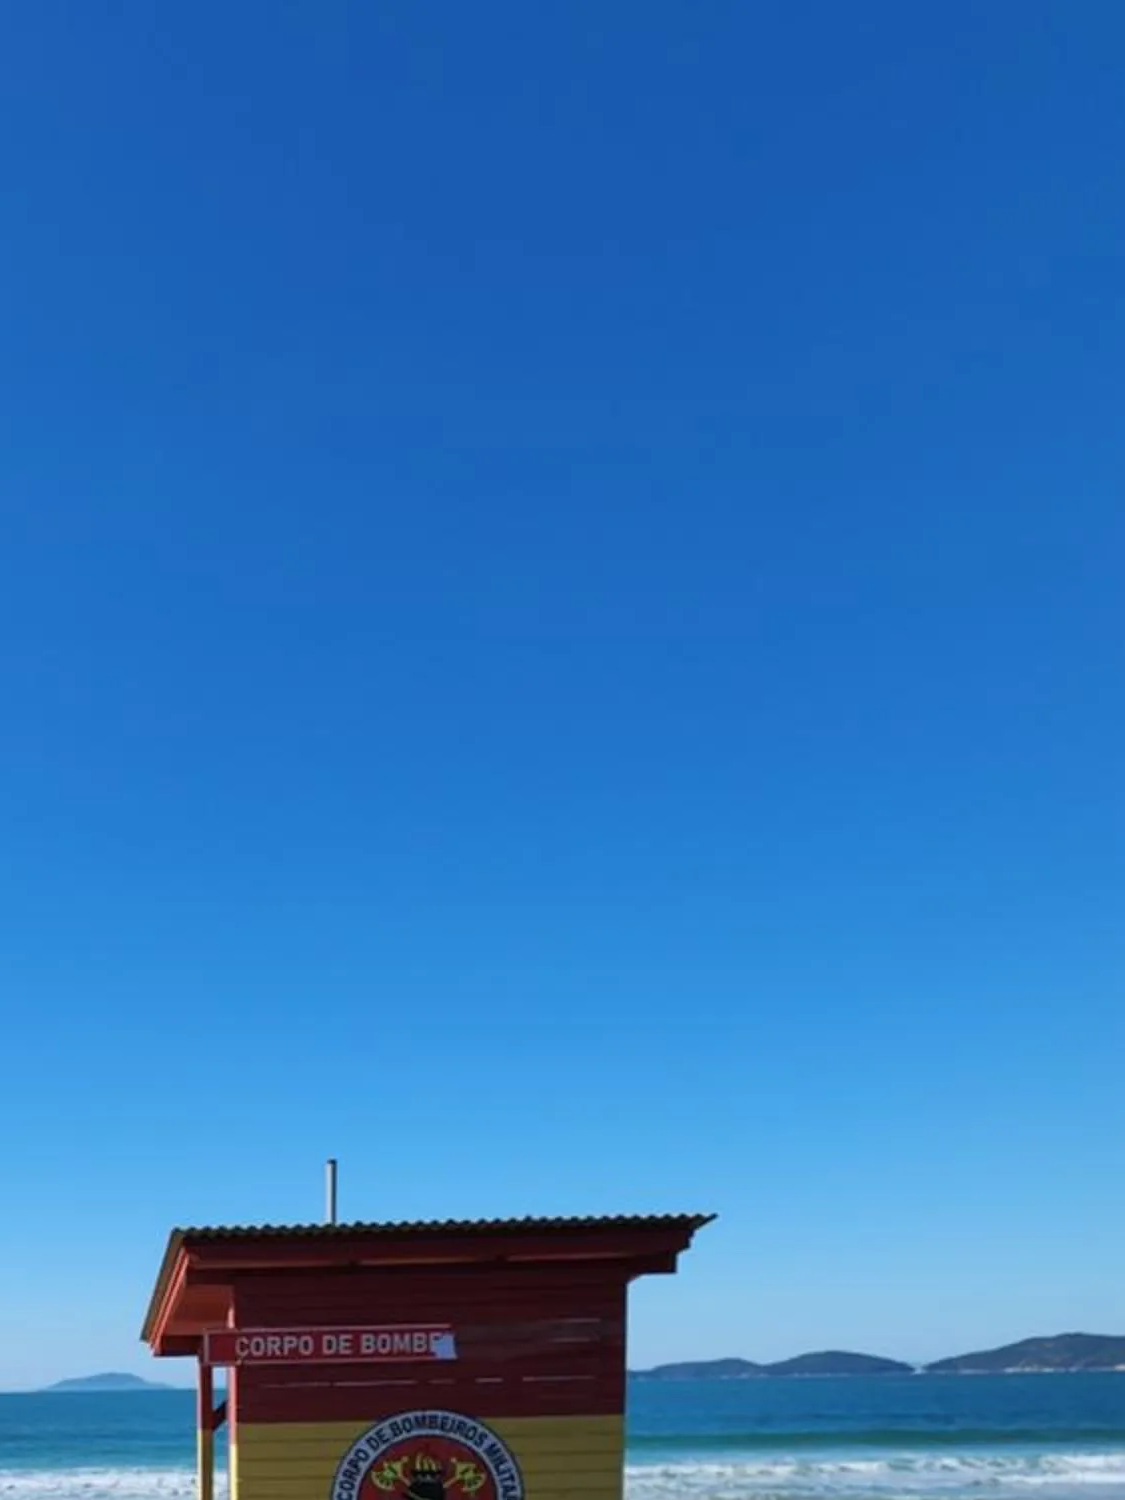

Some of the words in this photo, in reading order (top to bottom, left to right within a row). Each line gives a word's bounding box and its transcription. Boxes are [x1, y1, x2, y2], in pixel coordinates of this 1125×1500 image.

[235, 1335, 314, 1357] CORPO
[322, 1334, 354, 1355] DE
[366, 1426, 390, 1451] DE
[390, 1414, 488, 1447] BOMBEIROS
